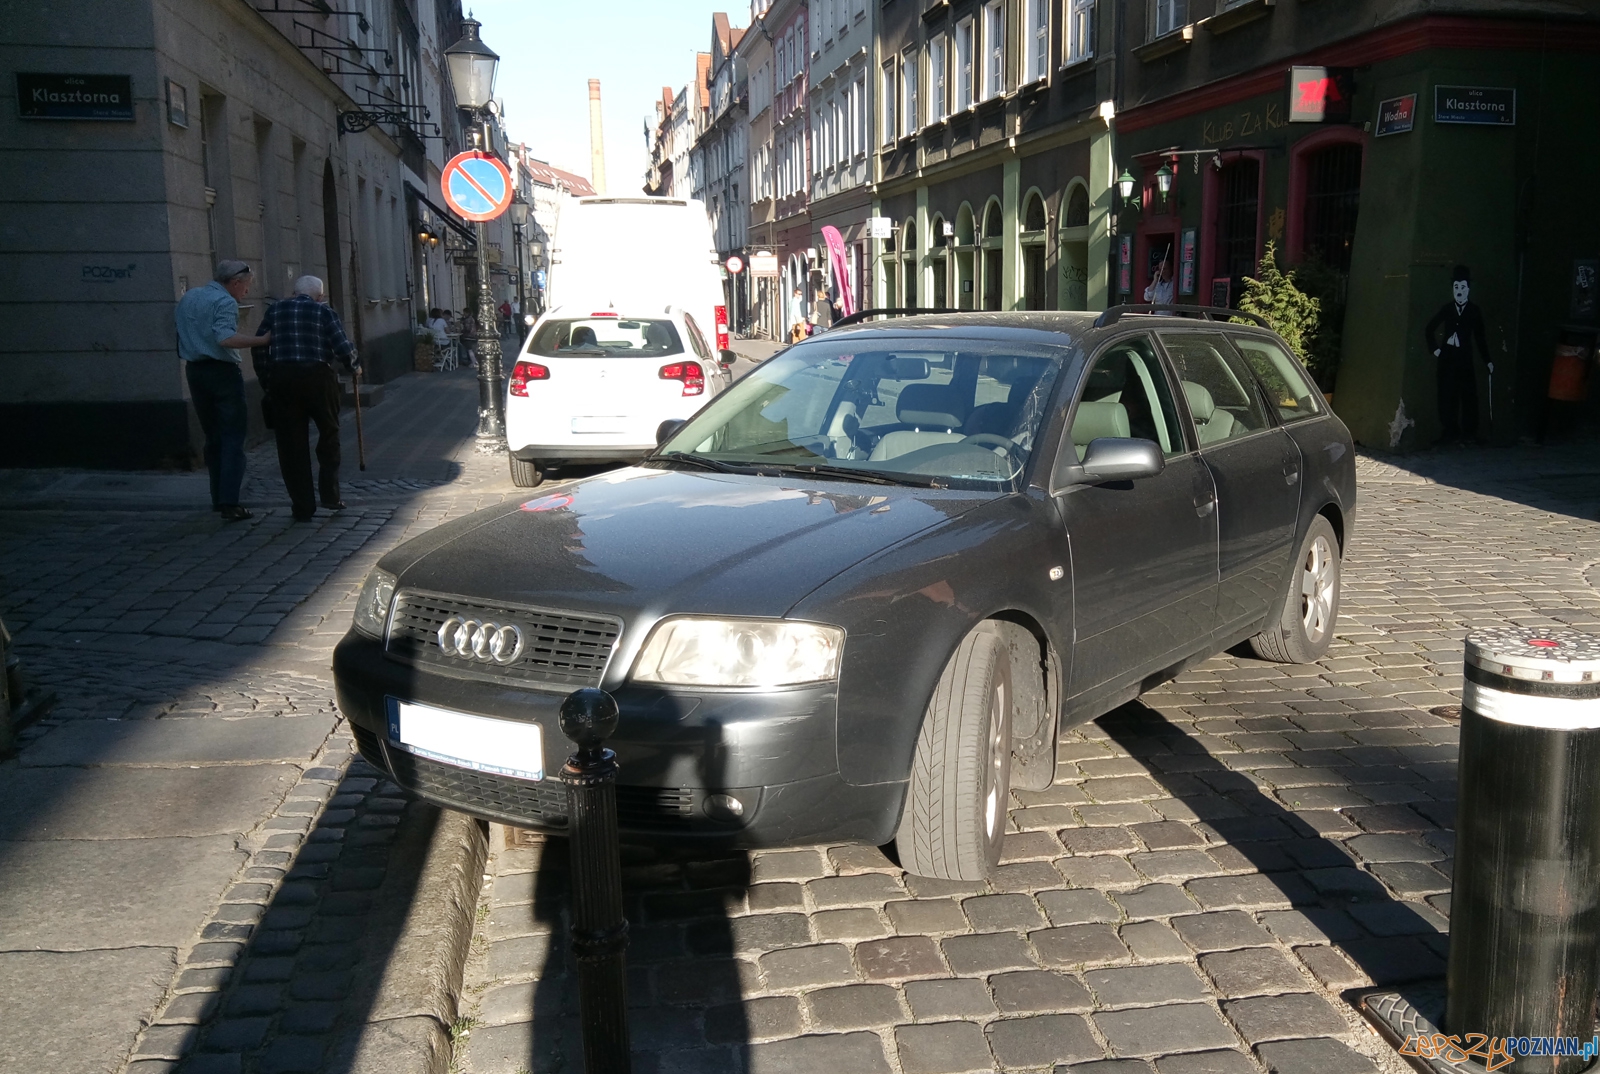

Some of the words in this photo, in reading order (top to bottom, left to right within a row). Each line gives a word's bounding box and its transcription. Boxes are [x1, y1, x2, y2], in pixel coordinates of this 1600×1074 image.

[64, 77, 85, 85] ulica
[32, 88, 120, 104] Klasztorna
[1468, 89, 1483, 97] ulica
[1446, 98, 1506, 112] Klasztorna
[1384, 109, 1408, 123] Wodna
[1202, 119, 1234, 146] KLUB
[1240, 111, 1262, 137] ZA
[390, 722, 399, 735] PL
